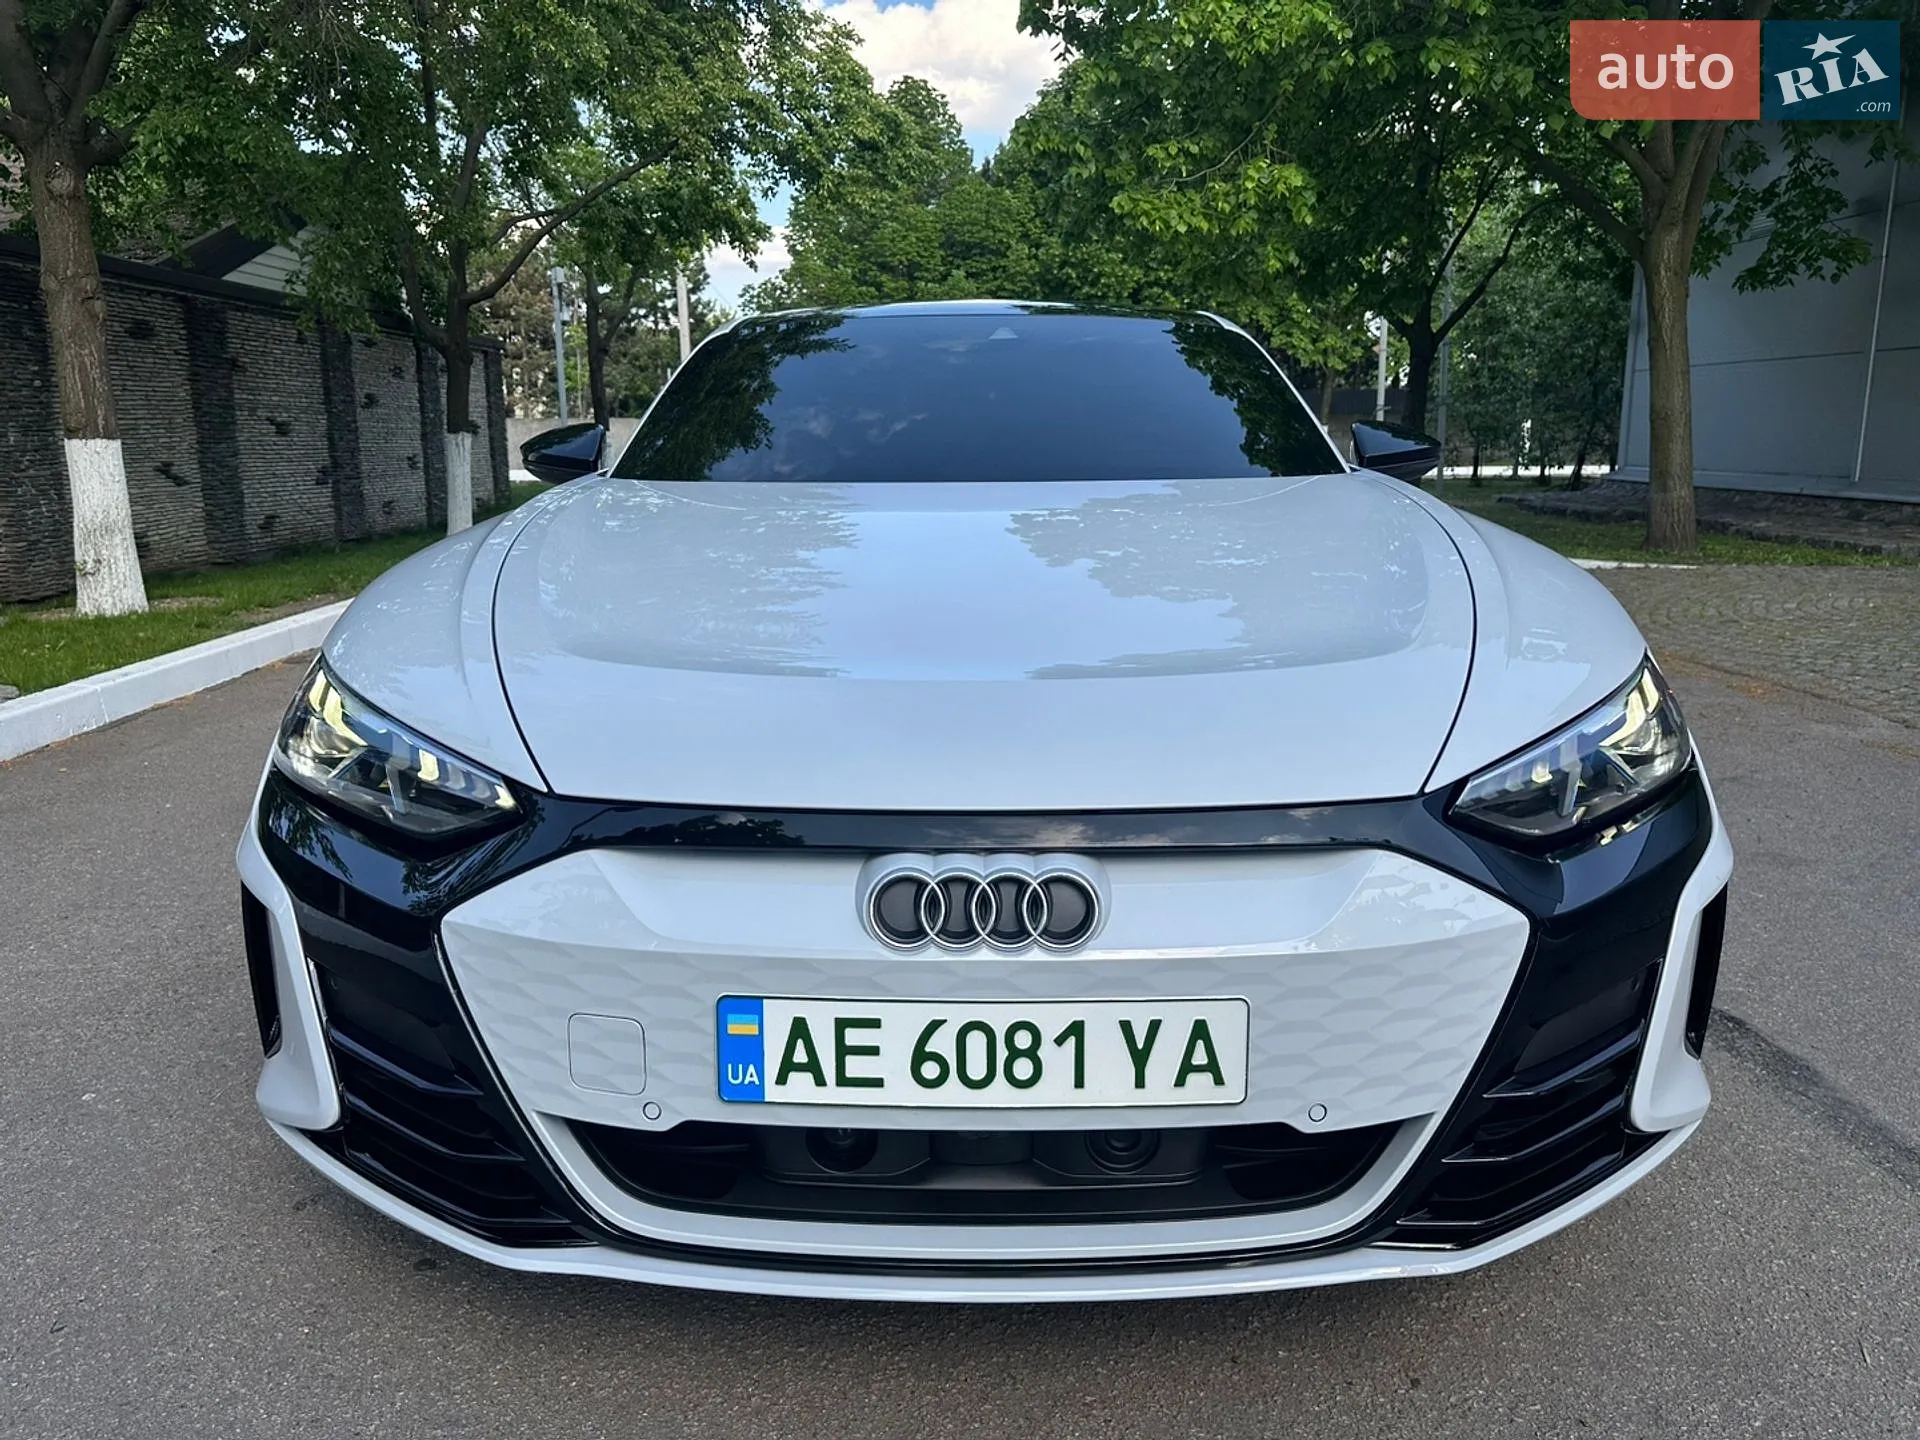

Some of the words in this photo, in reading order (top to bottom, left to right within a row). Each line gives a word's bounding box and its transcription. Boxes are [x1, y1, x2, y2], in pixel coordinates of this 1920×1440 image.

[727, 1064, 760, 1086] UA
[774, 1016, 885, 1088] AE
[910, 1018, 1085, 1090] 6081
[1118, 1018, 1227, 1089] YA
